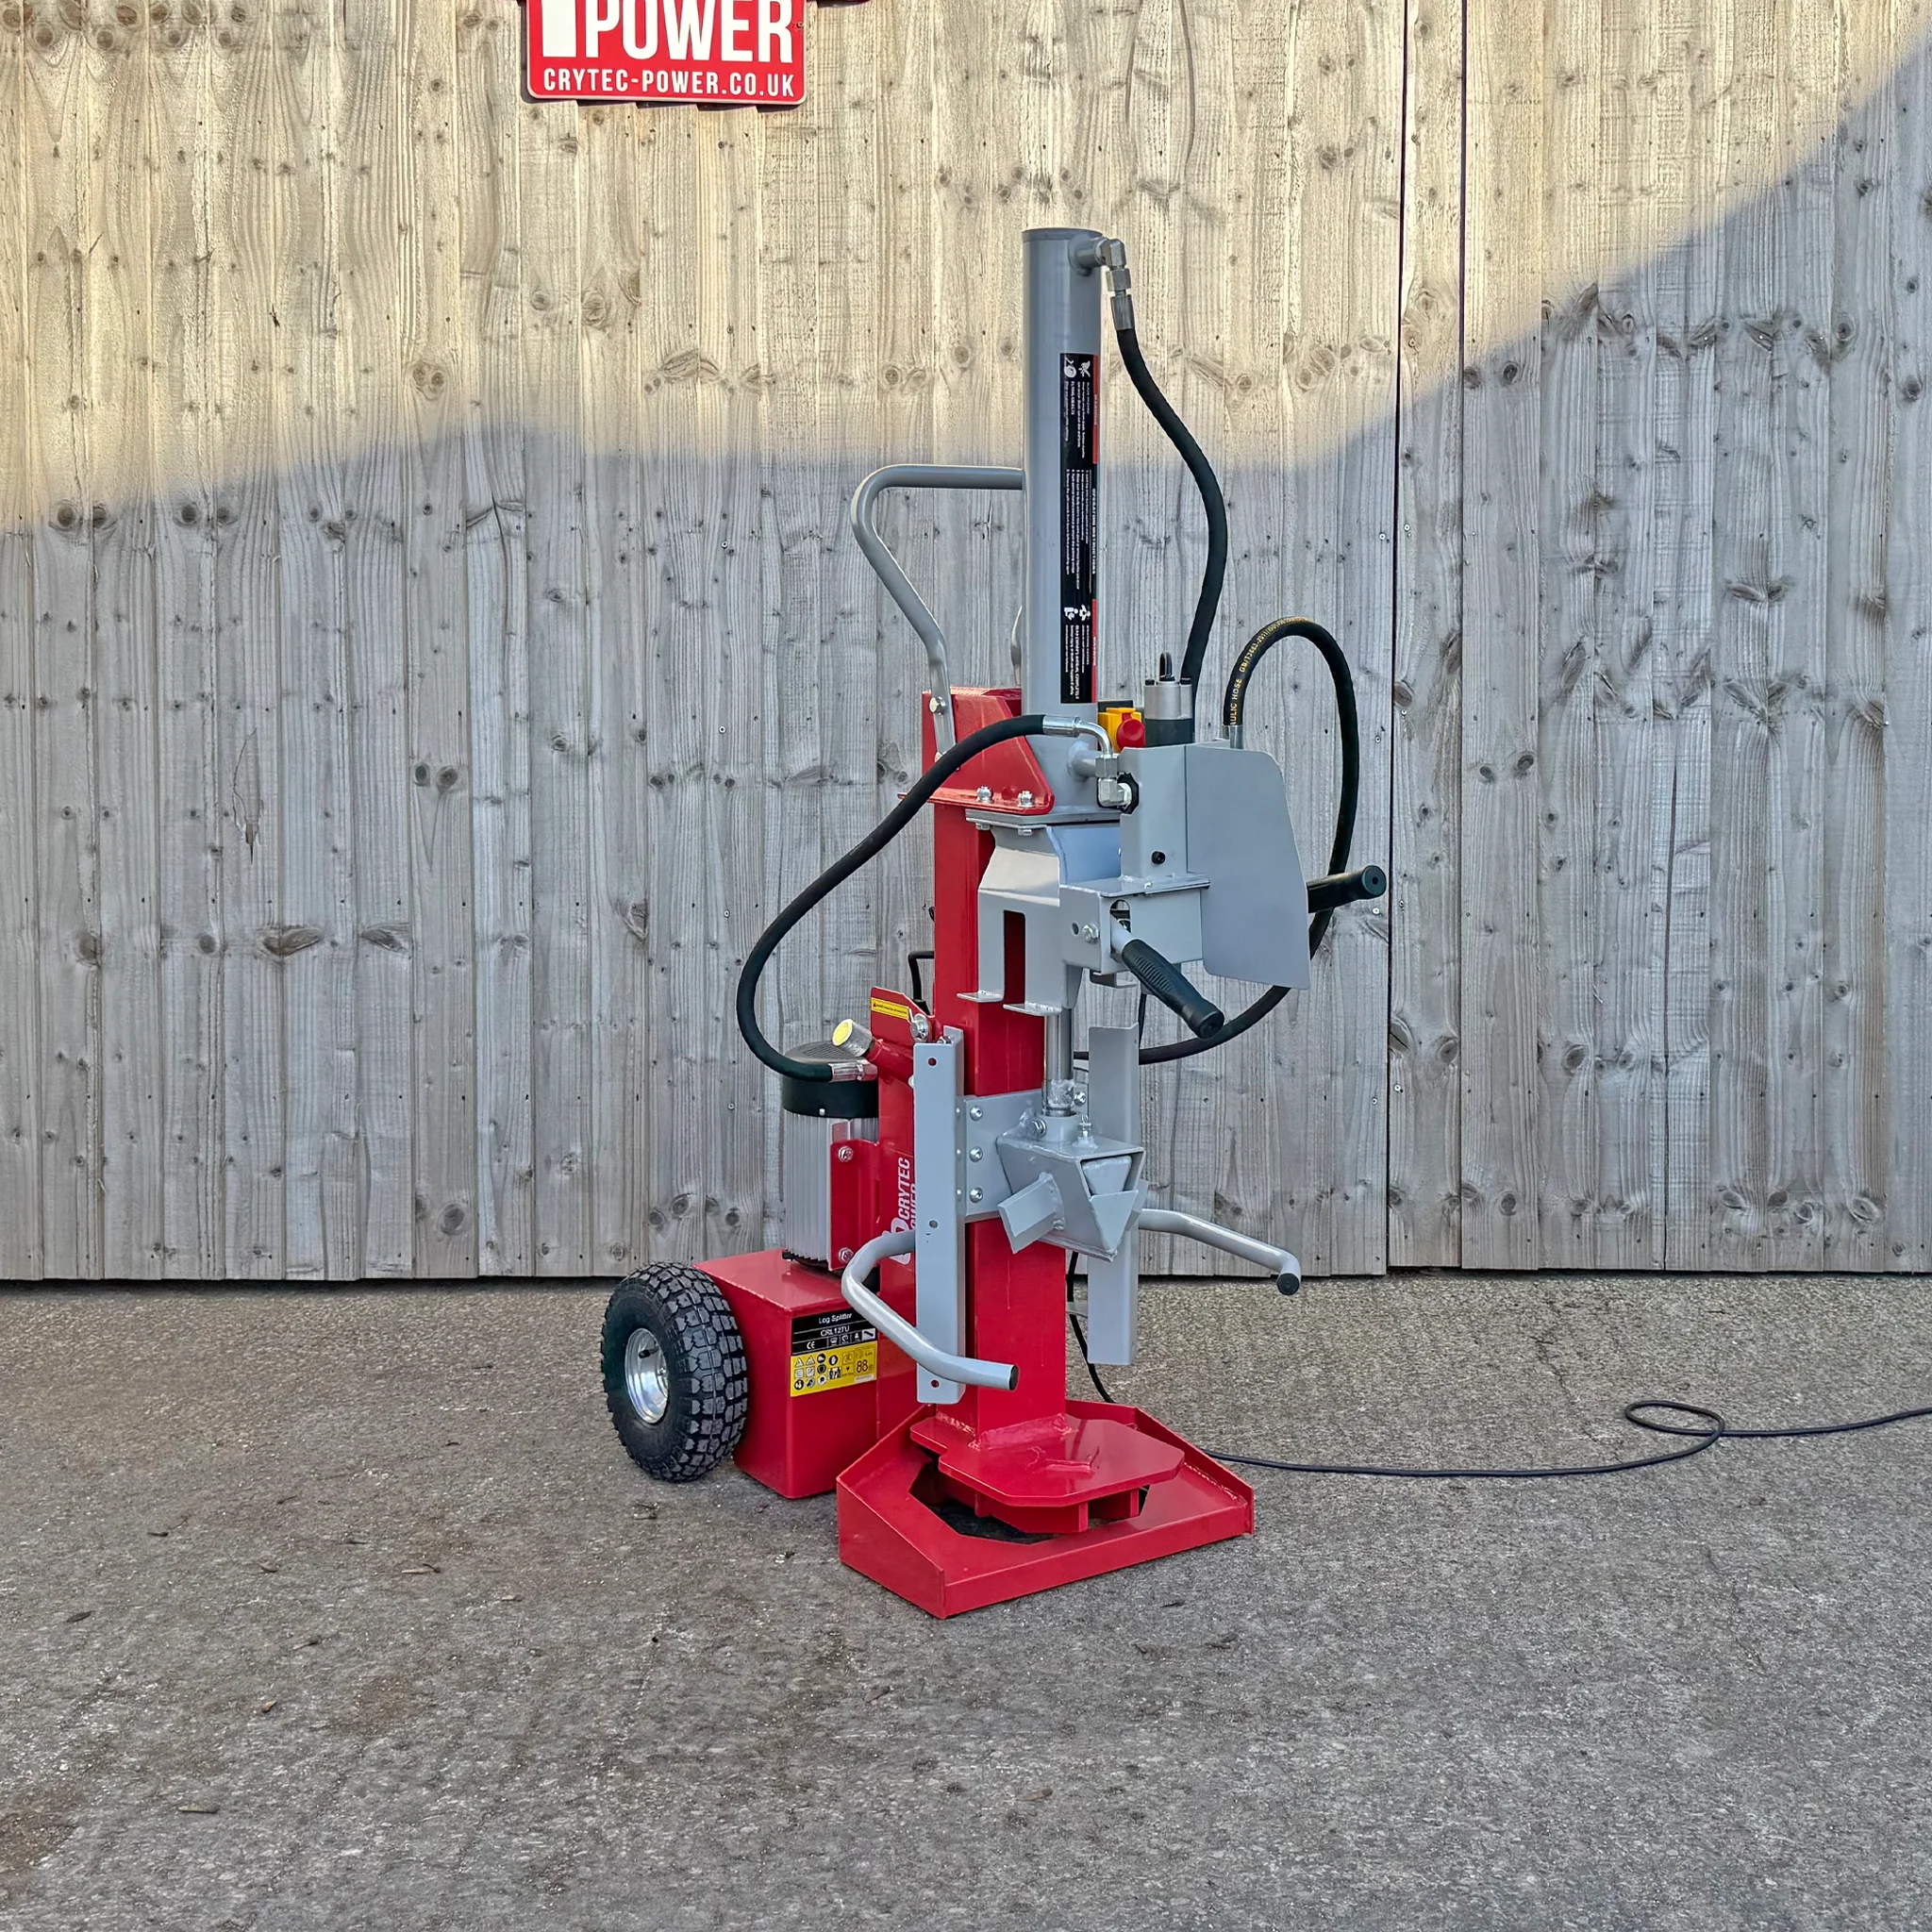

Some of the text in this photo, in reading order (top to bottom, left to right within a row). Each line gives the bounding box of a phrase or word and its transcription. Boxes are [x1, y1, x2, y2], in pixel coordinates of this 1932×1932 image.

[585, 0, 793, 63] POWER
[542, 67, 795, 97] CRYTEC-POWER.CO.UK
[1231, 678, 1242, 700] HOSE
[898, 1157, 910, 1221] CRYTEC
